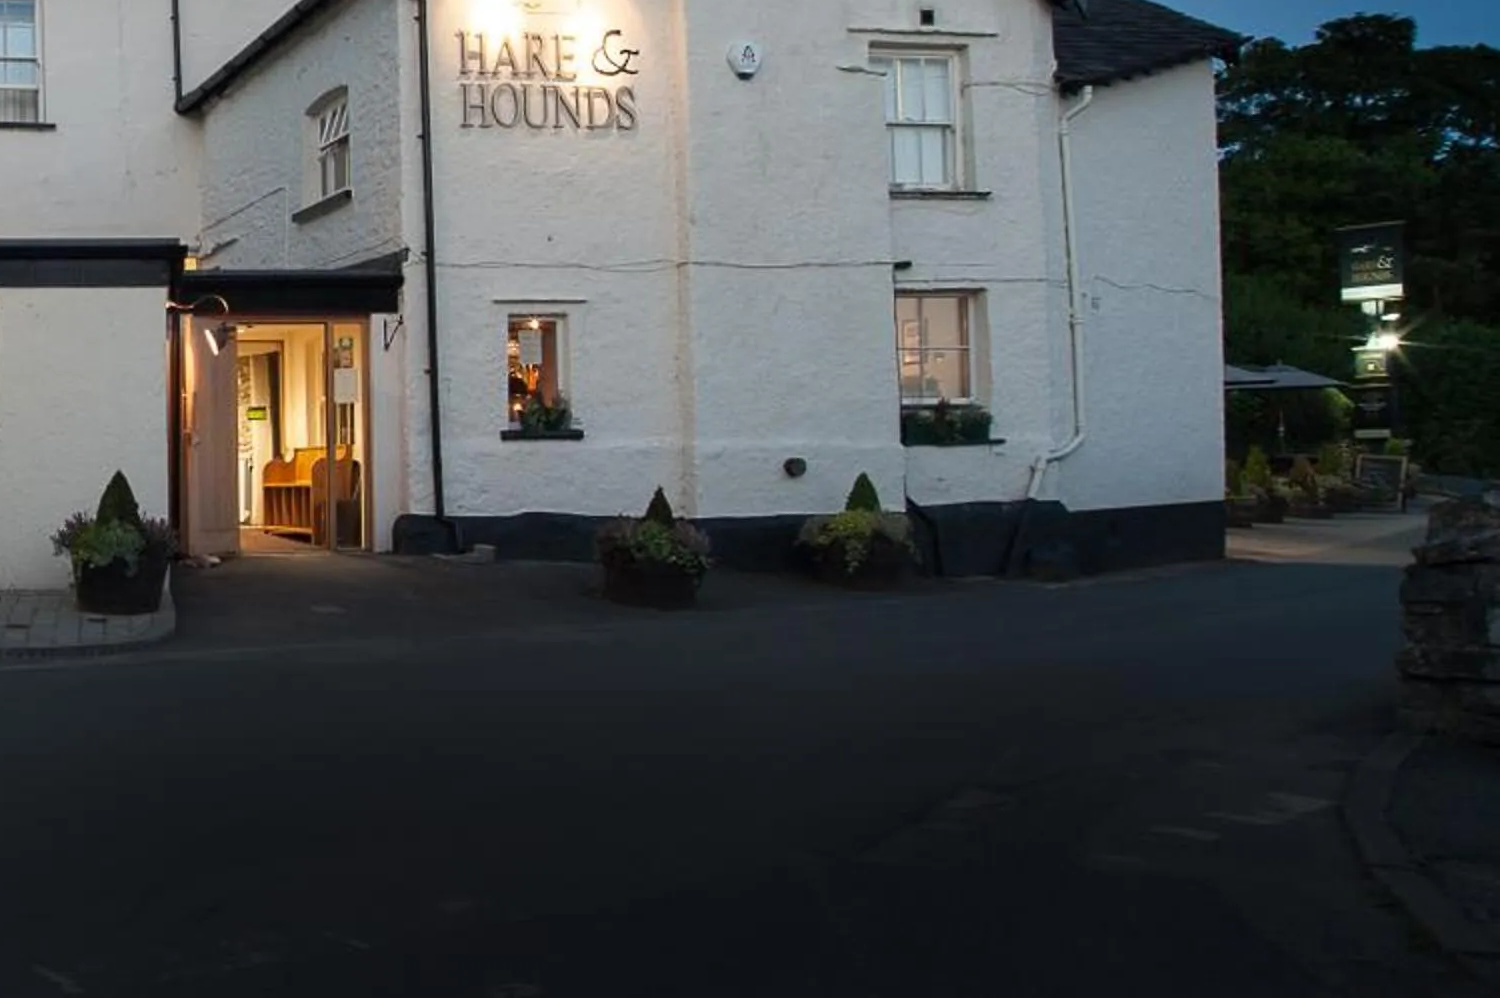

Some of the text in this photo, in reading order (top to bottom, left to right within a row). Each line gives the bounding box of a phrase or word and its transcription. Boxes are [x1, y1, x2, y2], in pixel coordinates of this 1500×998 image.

[456, 29, 640, 82] HARE &
[459, 82, 639, 131] HOUNDS
